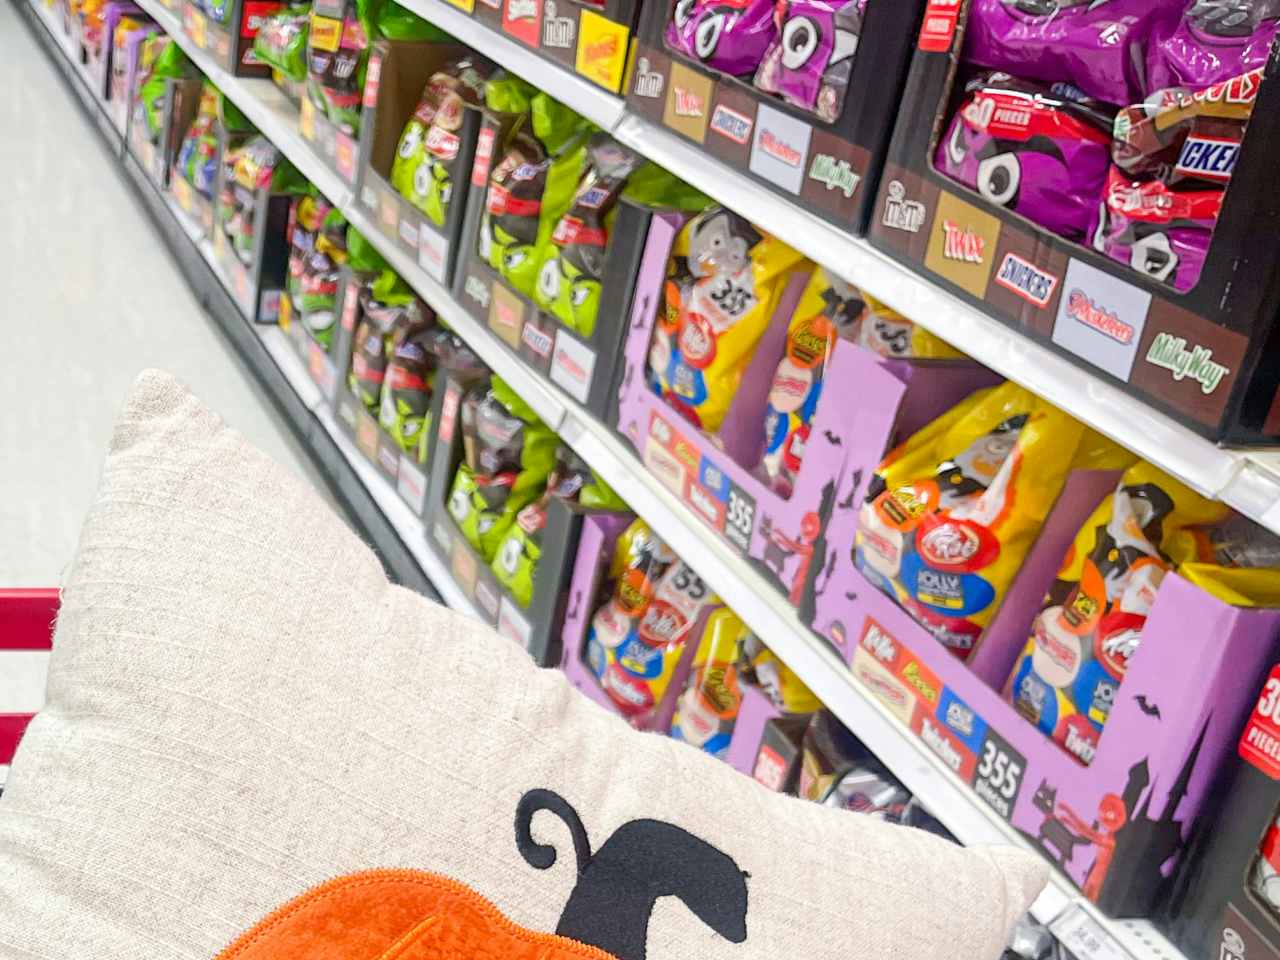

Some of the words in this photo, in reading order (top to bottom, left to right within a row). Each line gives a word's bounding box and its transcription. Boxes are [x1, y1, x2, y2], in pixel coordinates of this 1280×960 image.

[1146, 332, 1188, 380] Milky
[1187, 344, 1231, 393] Way
[977, 740, 1021, 799] 355
